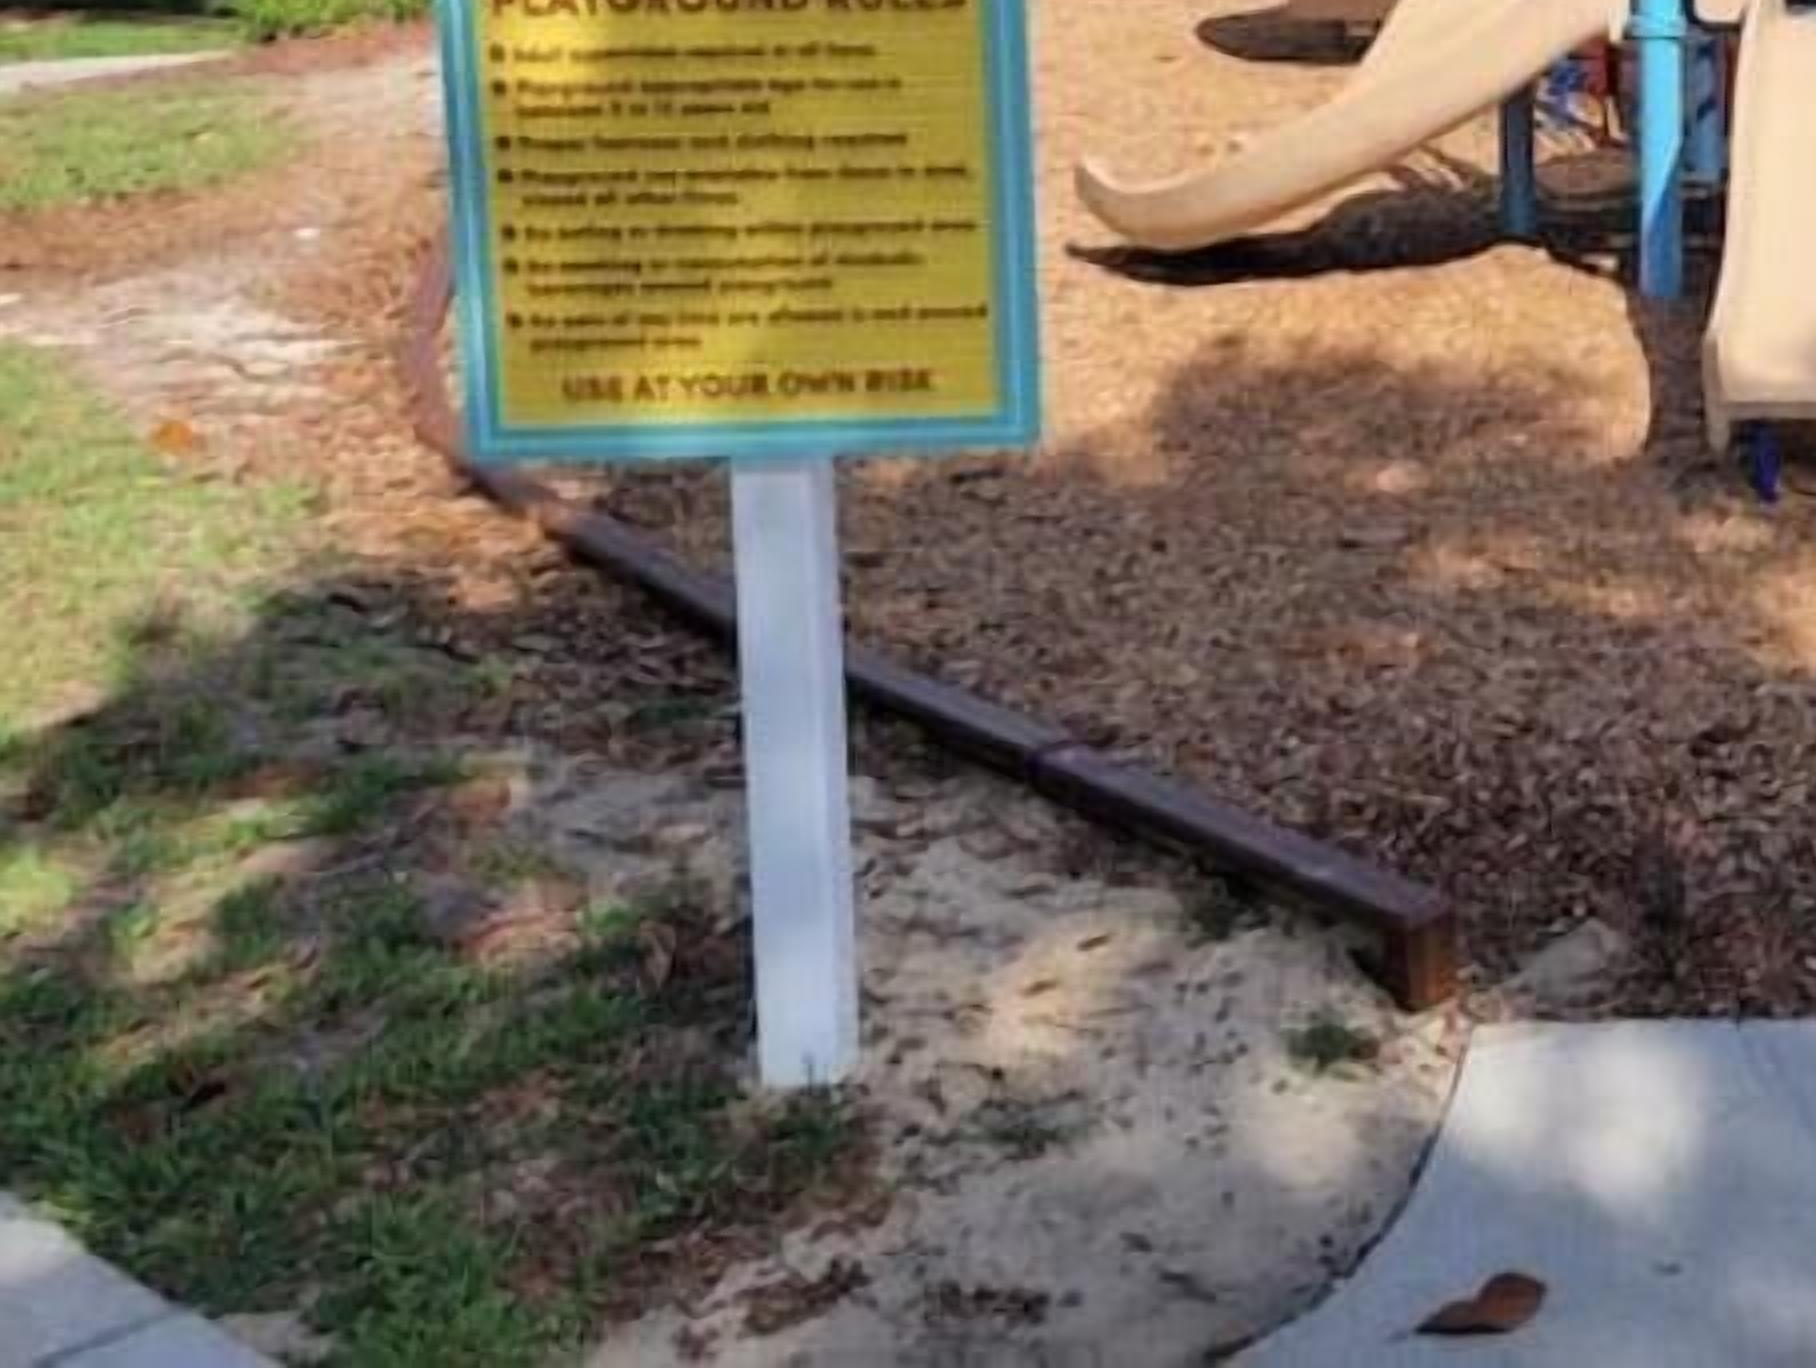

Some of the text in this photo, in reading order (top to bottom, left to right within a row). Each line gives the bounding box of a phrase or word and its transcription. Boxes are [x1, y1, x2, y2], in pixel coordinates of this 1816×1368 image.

[633, 375, 669, 402] AT
[679, 373, 768, 401] YOUR
[777, 370, 854, 399] OWN
